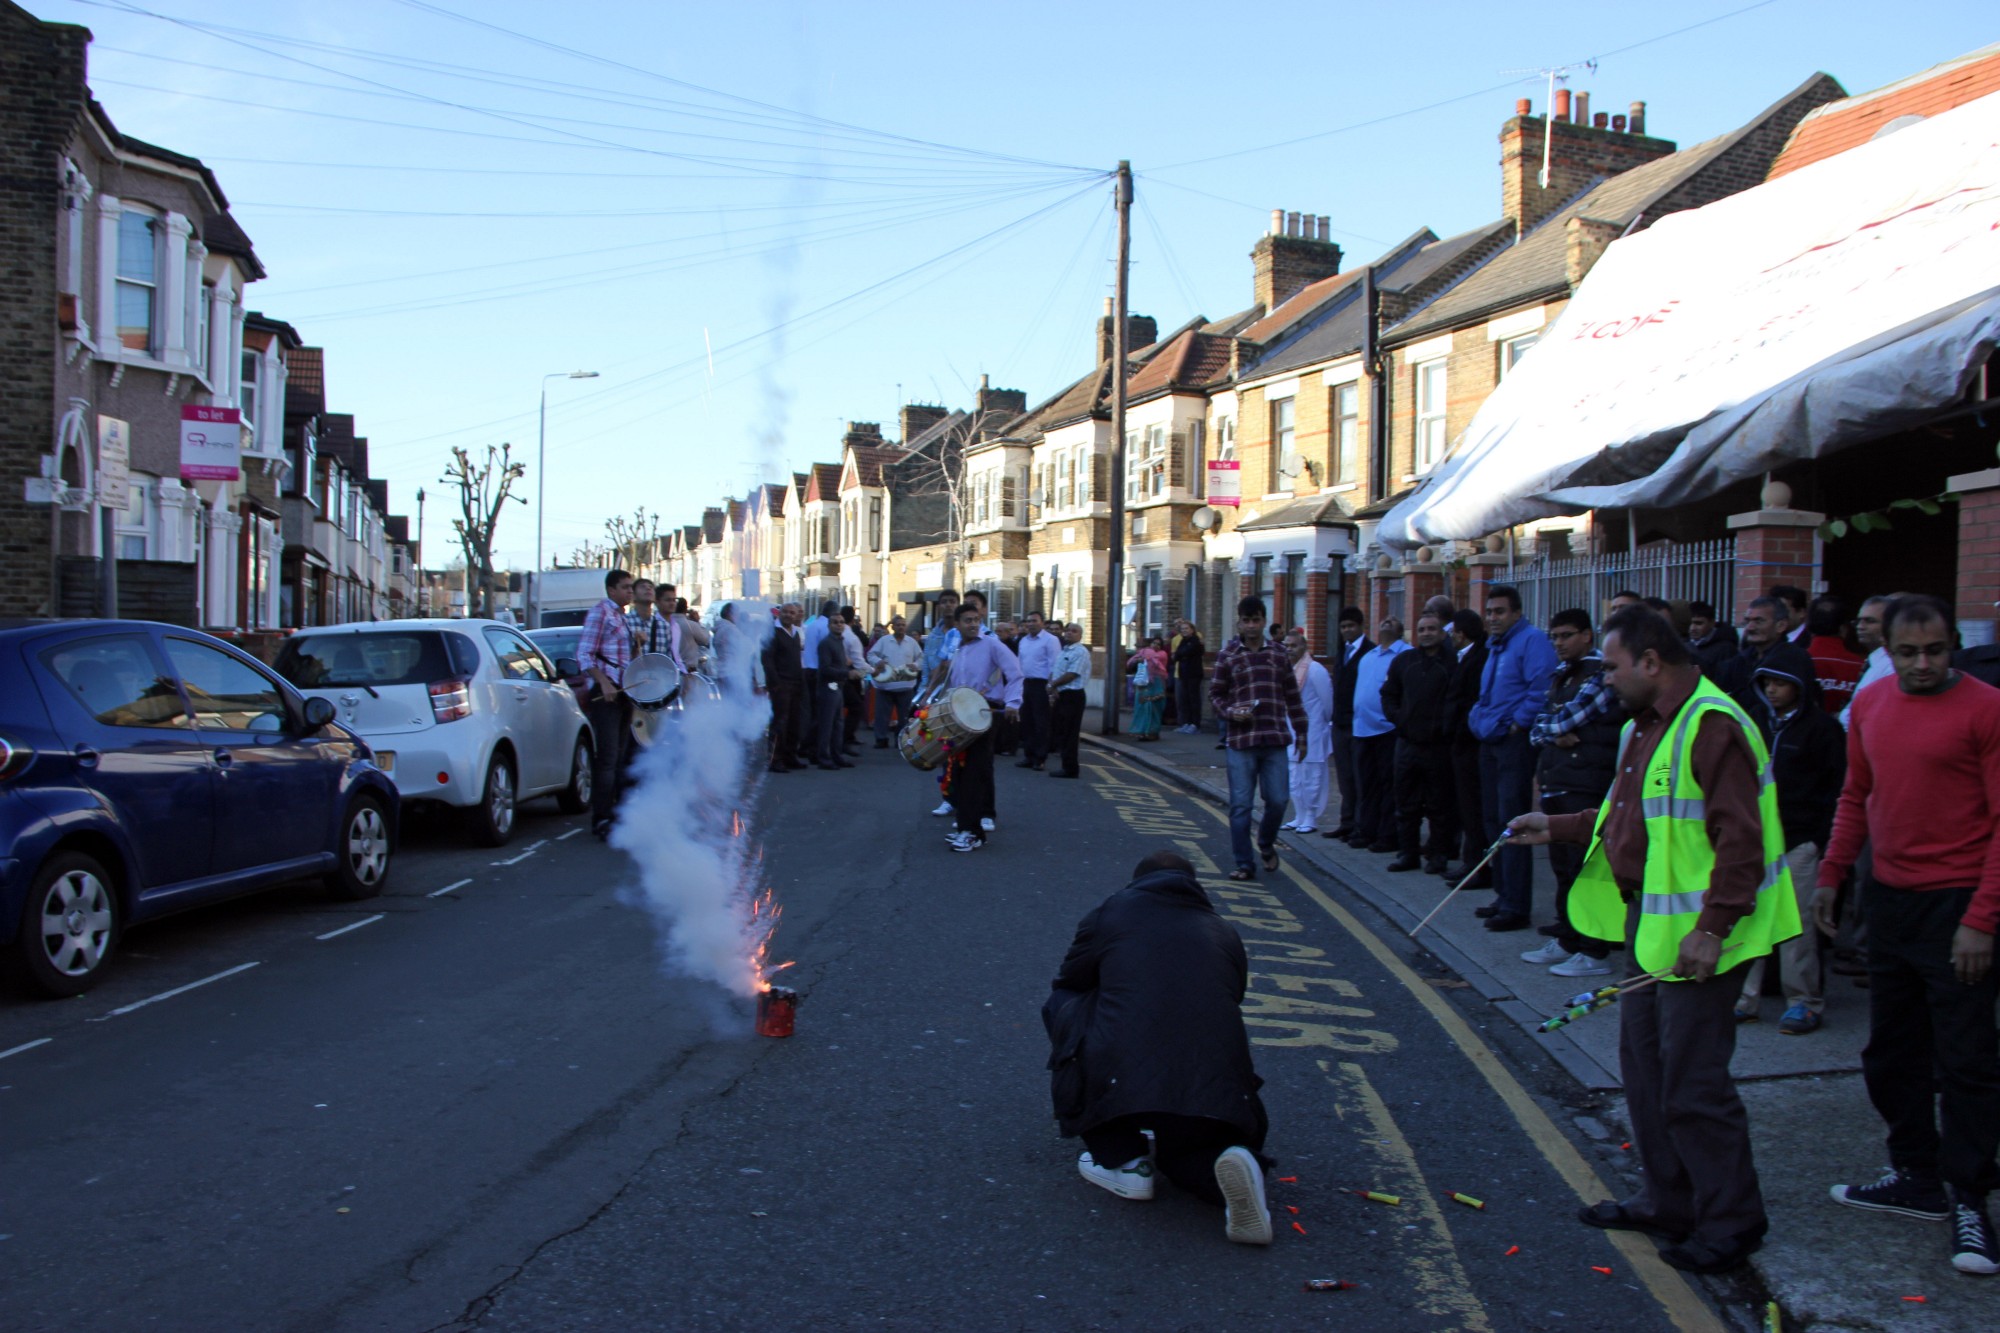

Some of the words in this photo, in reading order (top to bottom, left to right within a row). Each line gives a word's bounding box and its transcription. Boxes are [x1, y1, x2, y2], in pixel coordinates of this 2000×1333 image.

[198, 410, 208, 419] to
[211, 409, 224, 420] let
[1115, 806, 1208, 838] CLEAR
[1196, 877, 1304, 932] KEEP
[1240, 939, 1399, 1053] CLEAR
